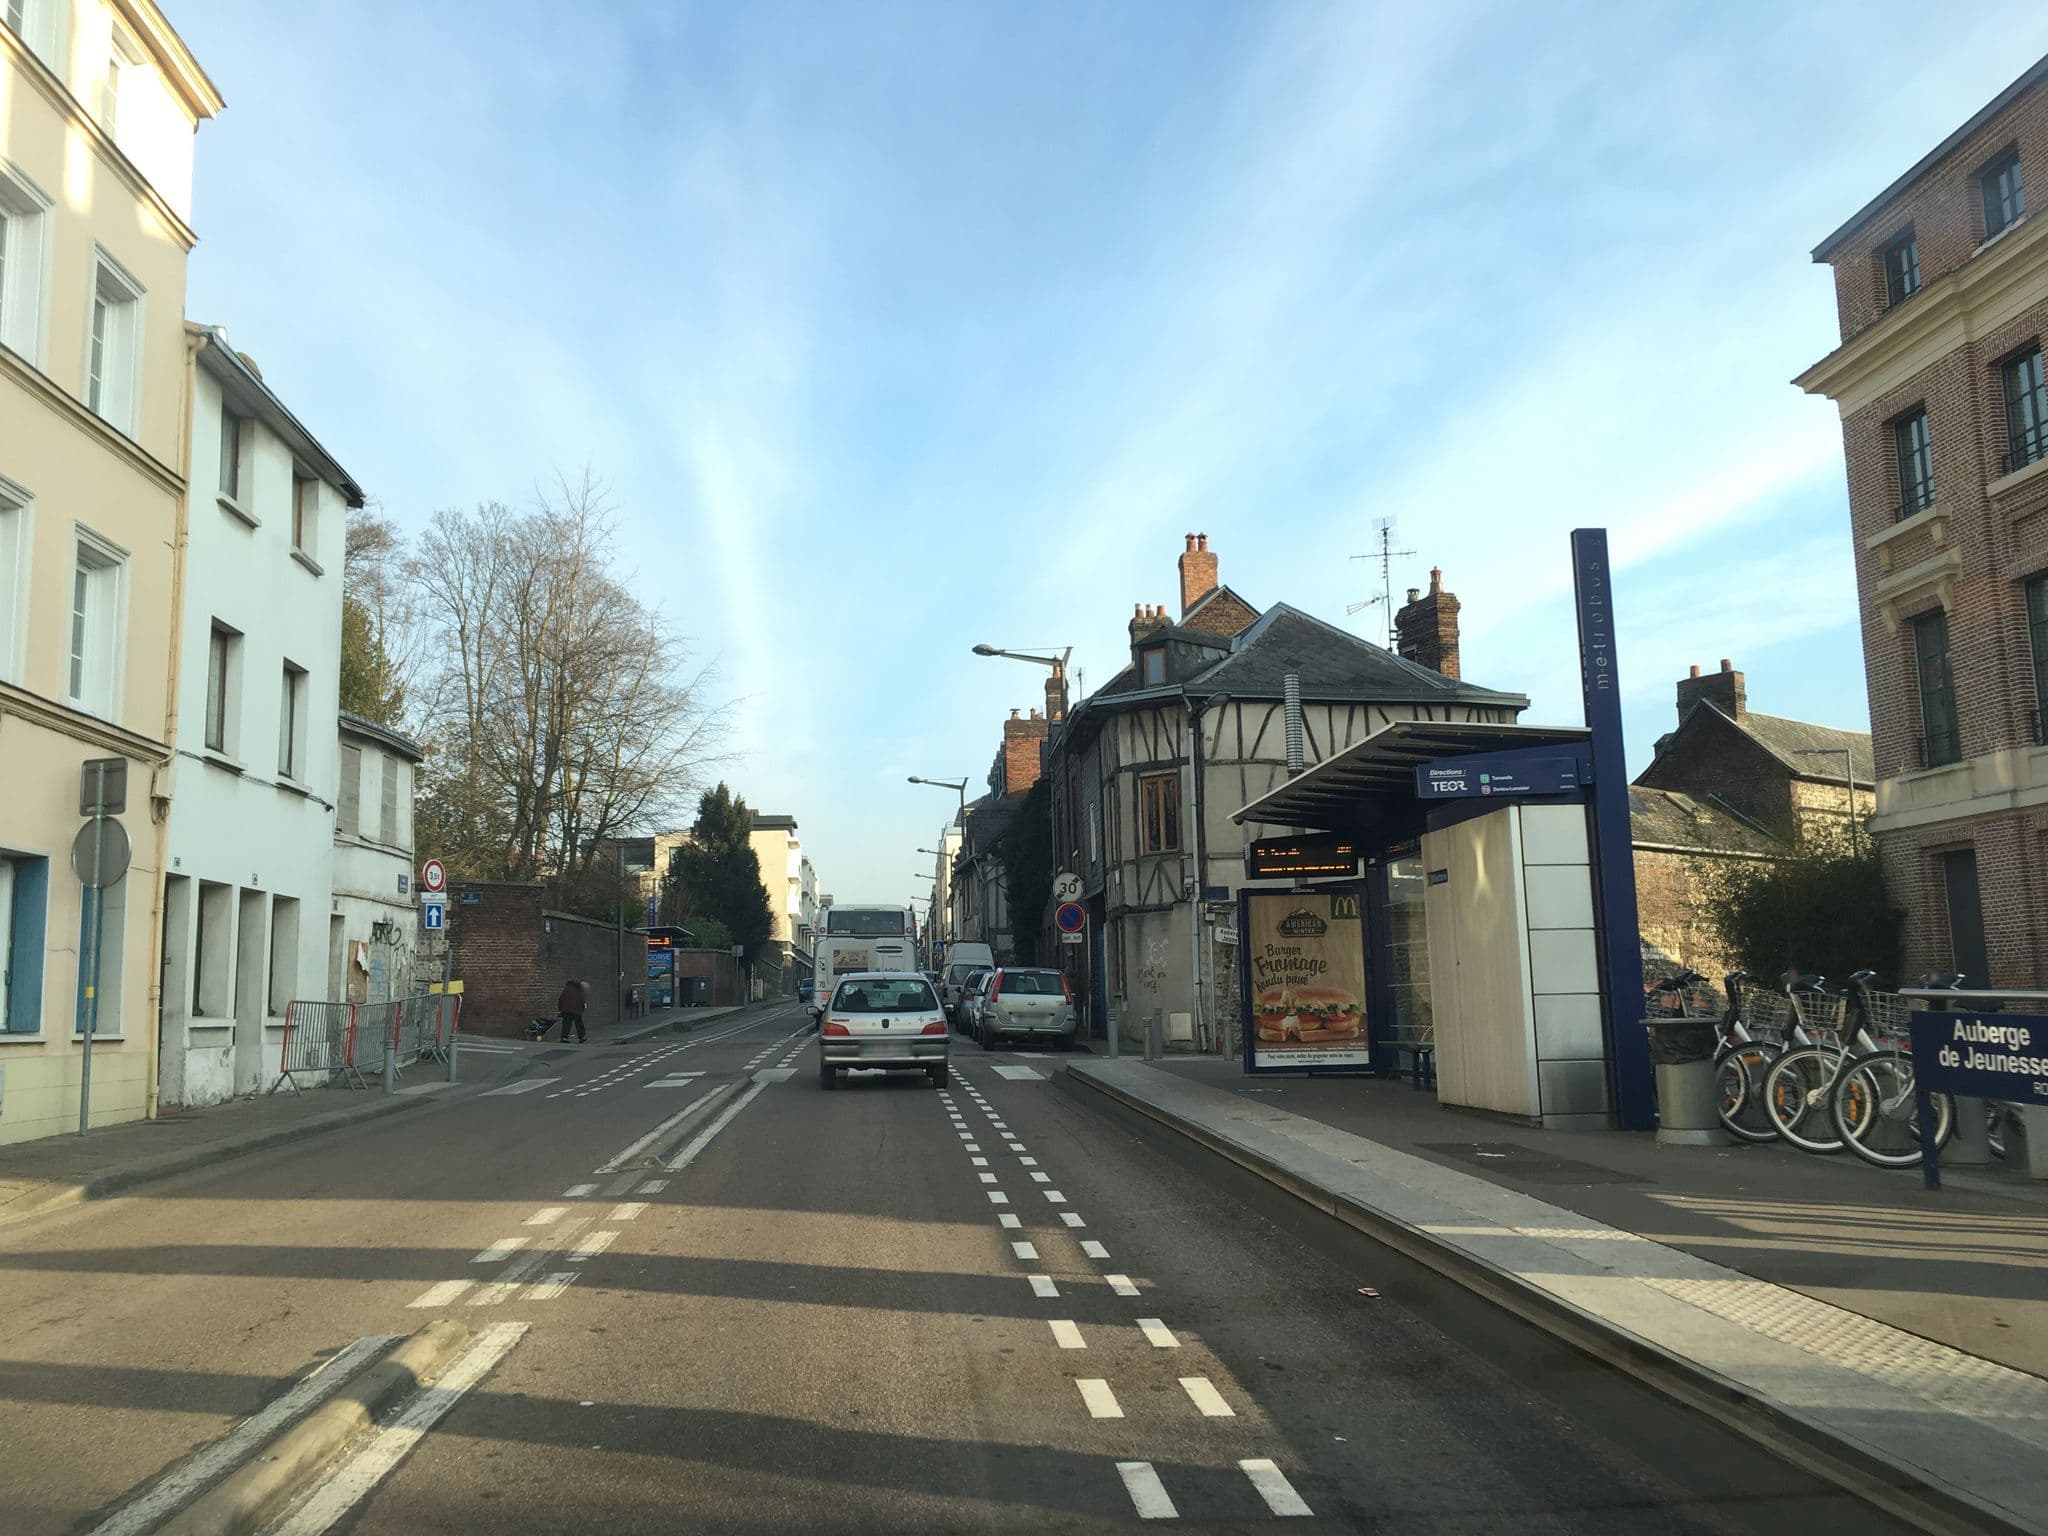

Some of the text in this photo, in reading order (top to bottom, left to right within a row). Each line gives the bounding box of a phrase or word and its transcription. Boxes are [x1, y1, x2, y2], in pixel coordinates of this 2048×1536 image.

[1431, 780, 1468, 792] TEOR
[1060, 883, 1077, 894] 30
[1286, 919, 1322, 928] AMERICAN
[1264, 943, 1302, 957] Burger
[1253, 956, 1327, 977] Fromage
[1953, 1019, 2031, 1051] Auberge
[1939, 1044, 2048, 1077] de Jeunesse
